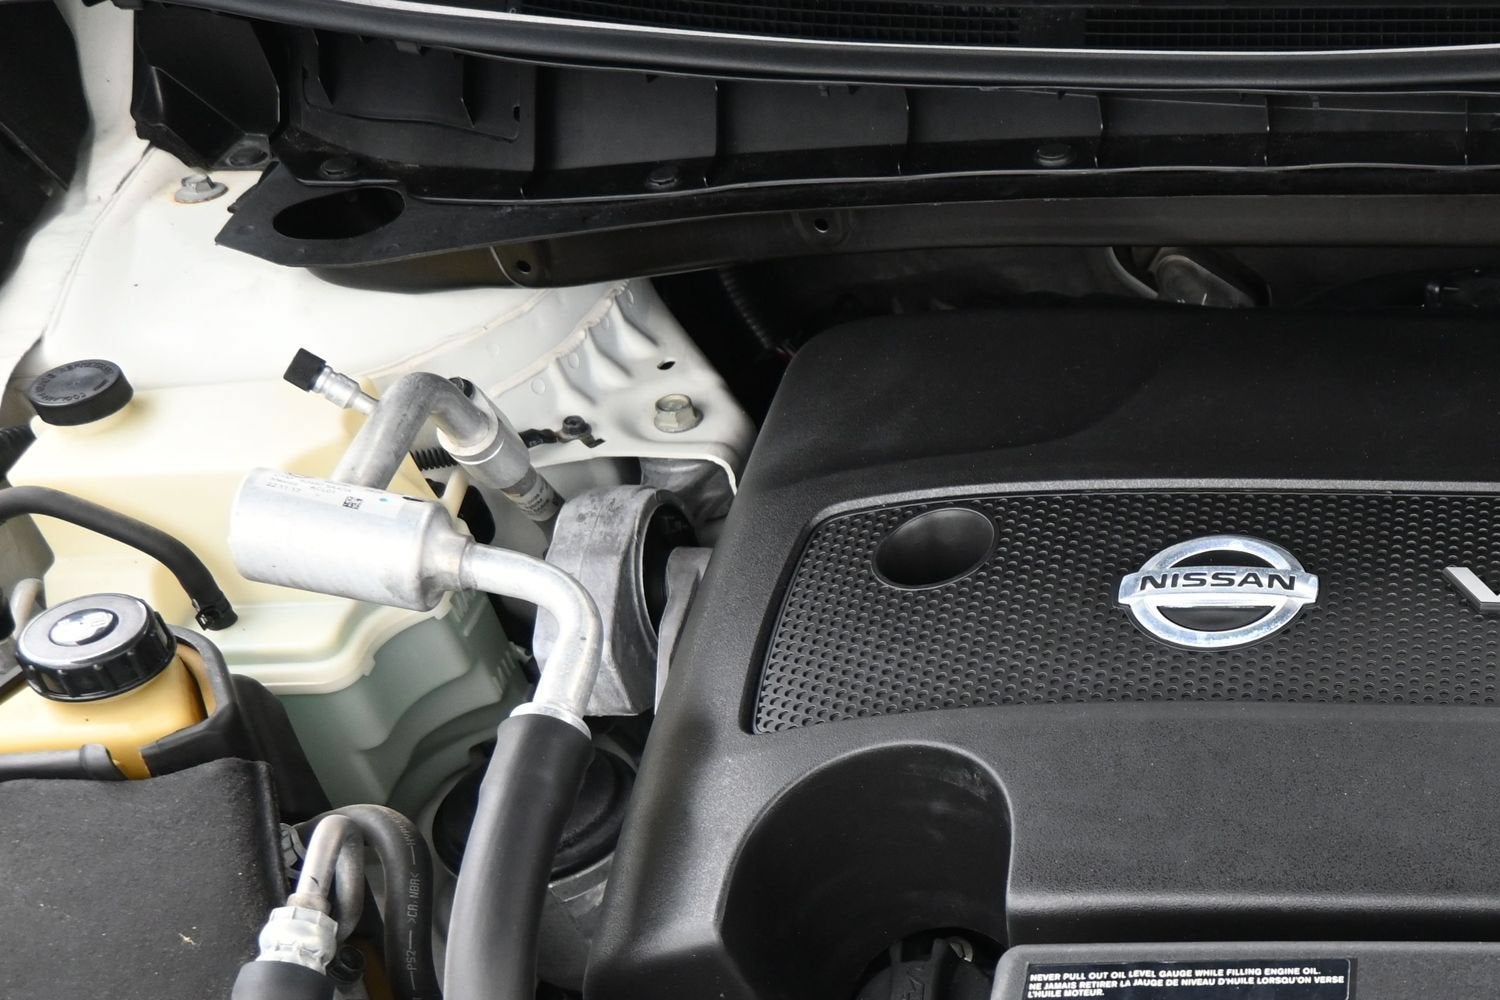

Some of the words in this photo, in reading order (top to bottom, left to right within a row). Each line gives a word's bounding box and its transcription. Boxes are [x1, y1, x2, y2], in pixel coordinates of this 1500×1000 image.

[1138, 571, 1297, 592] NISSAN
[1030, 974, 1061, 982] NEVER
[1063, 973, 1086, 981] PULL
[1088, 972, 1108, 980] OUT
[1111, 971, 1126, 979] OIL
[1128, 970, 1156, 978] LEVEL
[1159, 969, 1192, 978] GAUGE
[1195, 969, 1224, 977] WHILE
[1226, 968, 1262, 976] FILLING
[1264, 967, 1300, 976] ENGINE
[1302, 967, 1321, 975] OIL.
[1028, 983, 1042, 991] NE
[1044, 982, 1077, 990] JAMAIS
[1079, 980, 1118, 989] RETIRER
[1120, 979, 1132, 987] LA
[1133, 979, 1164, 987] JAUGE
[1166, 978, 1178, 987] DE
[1181, 978, 1216, 986] NIVEAU
[1218, 977, 1254, 985] D'HUILE
[1257, 976, 1312, 985] LORSQU'ON
[1314, 975, 1344, 984] VERSE
[1028, 990, 1062, 998] L'HUILE
[1064, 989, 1104, 998] MOTEUR.
